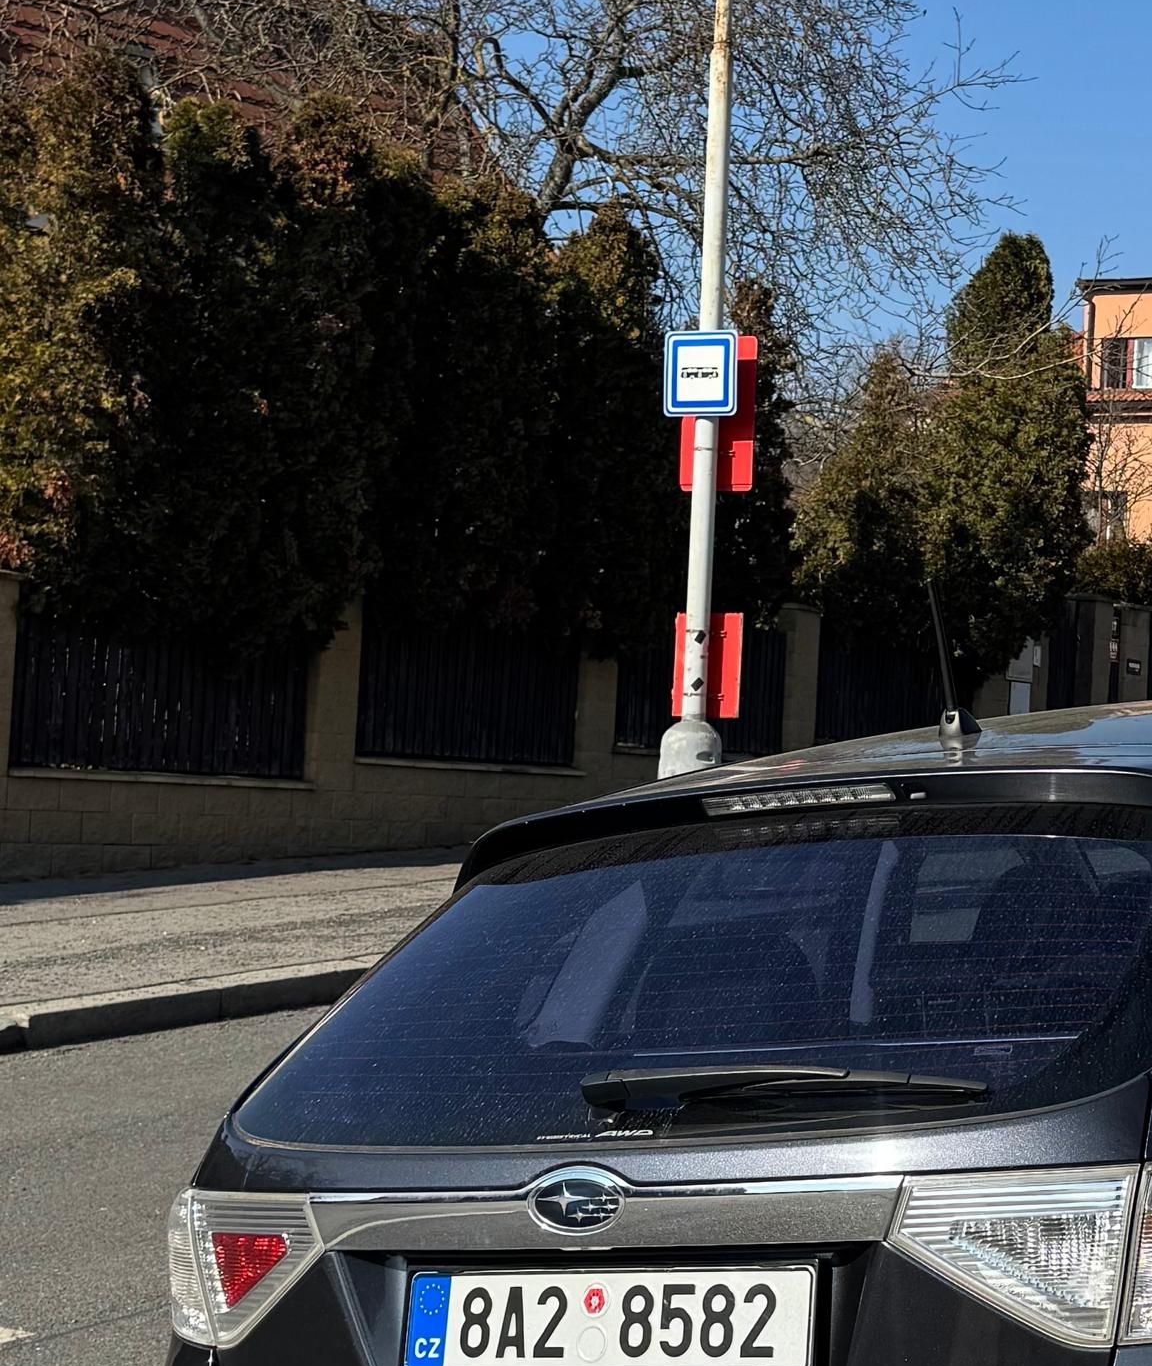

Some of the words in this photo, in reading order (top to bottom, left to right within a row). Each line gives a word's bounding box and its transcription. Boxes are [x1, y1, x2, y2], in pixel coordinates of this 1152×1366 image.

[594, 1129, 653, 1138] AWD
[459, 1285, 568, 1359] 8A2
[619, 1283, 777, 1358] 8582
[414, 1337, 441, 1359] CZ
